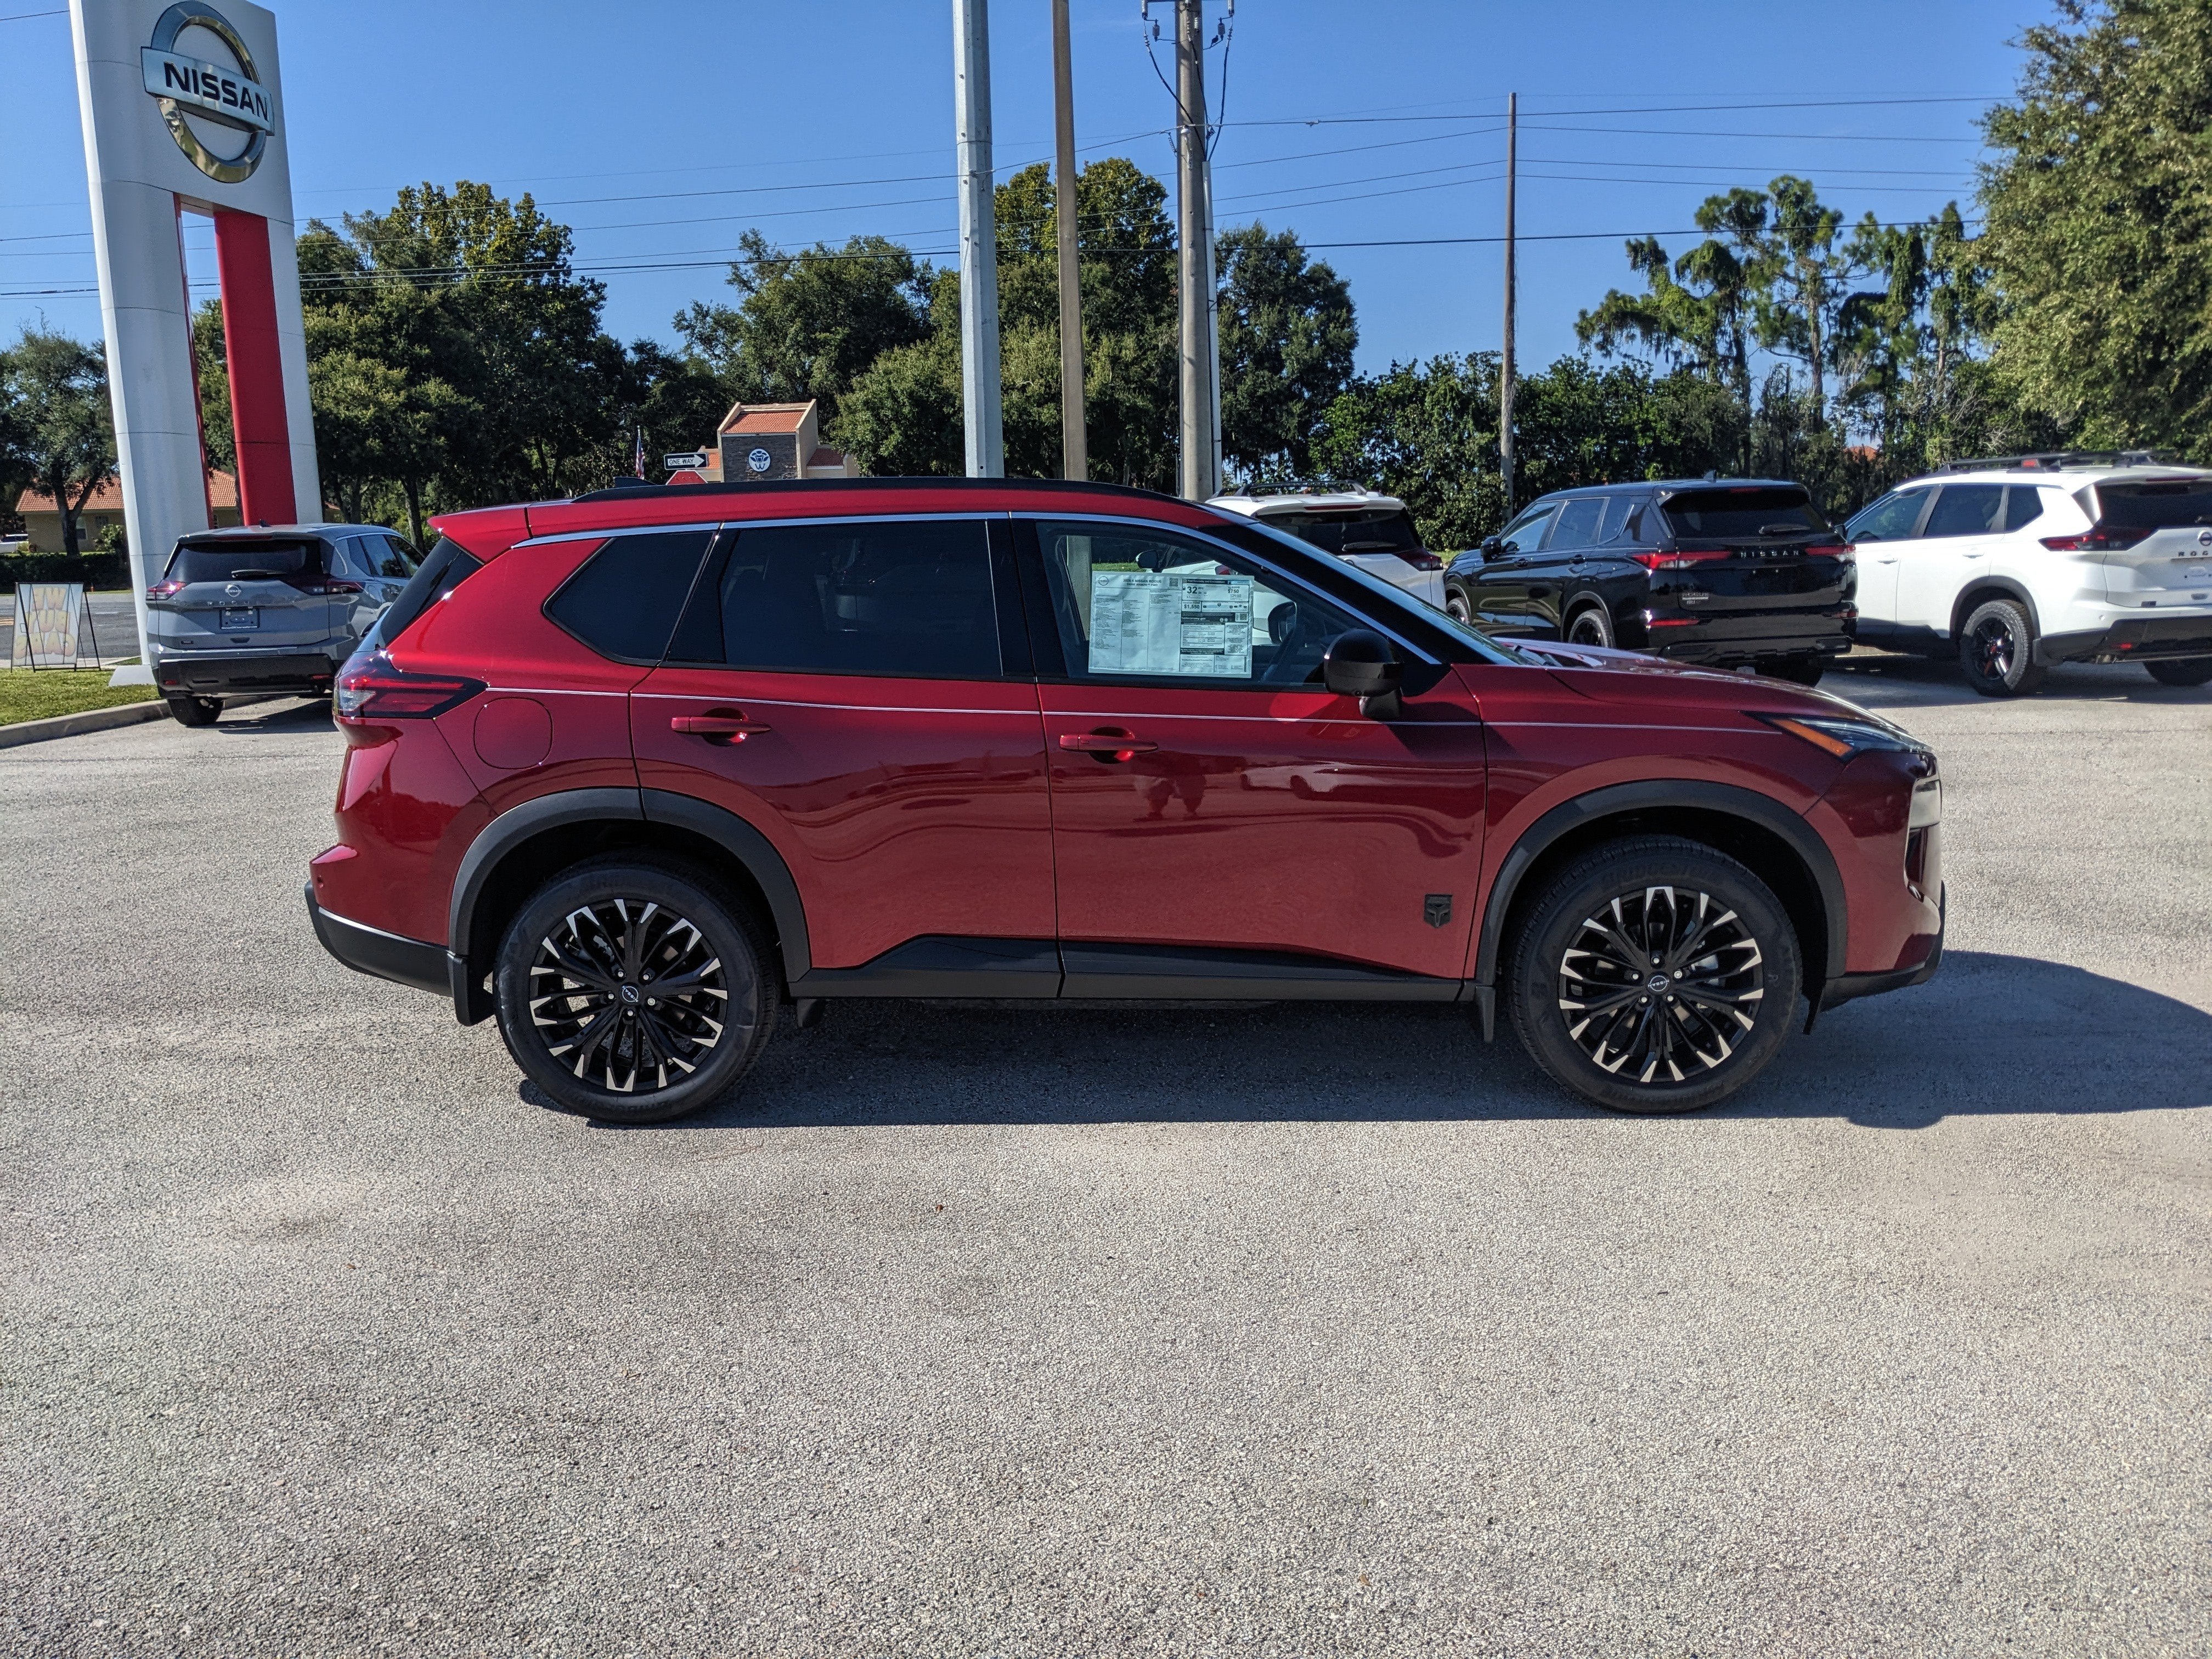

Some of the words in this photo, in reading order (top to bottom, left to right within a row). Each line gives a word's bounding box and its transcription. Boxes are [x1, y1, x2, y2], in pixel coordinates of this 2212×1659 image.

[163, 61, 269, 122] NISSAN
[1740, 550, 1799, 558] NISSAN
[1187, 586, 1198, 594] 32
[1647, 979, 1669, 988] NISSAN
